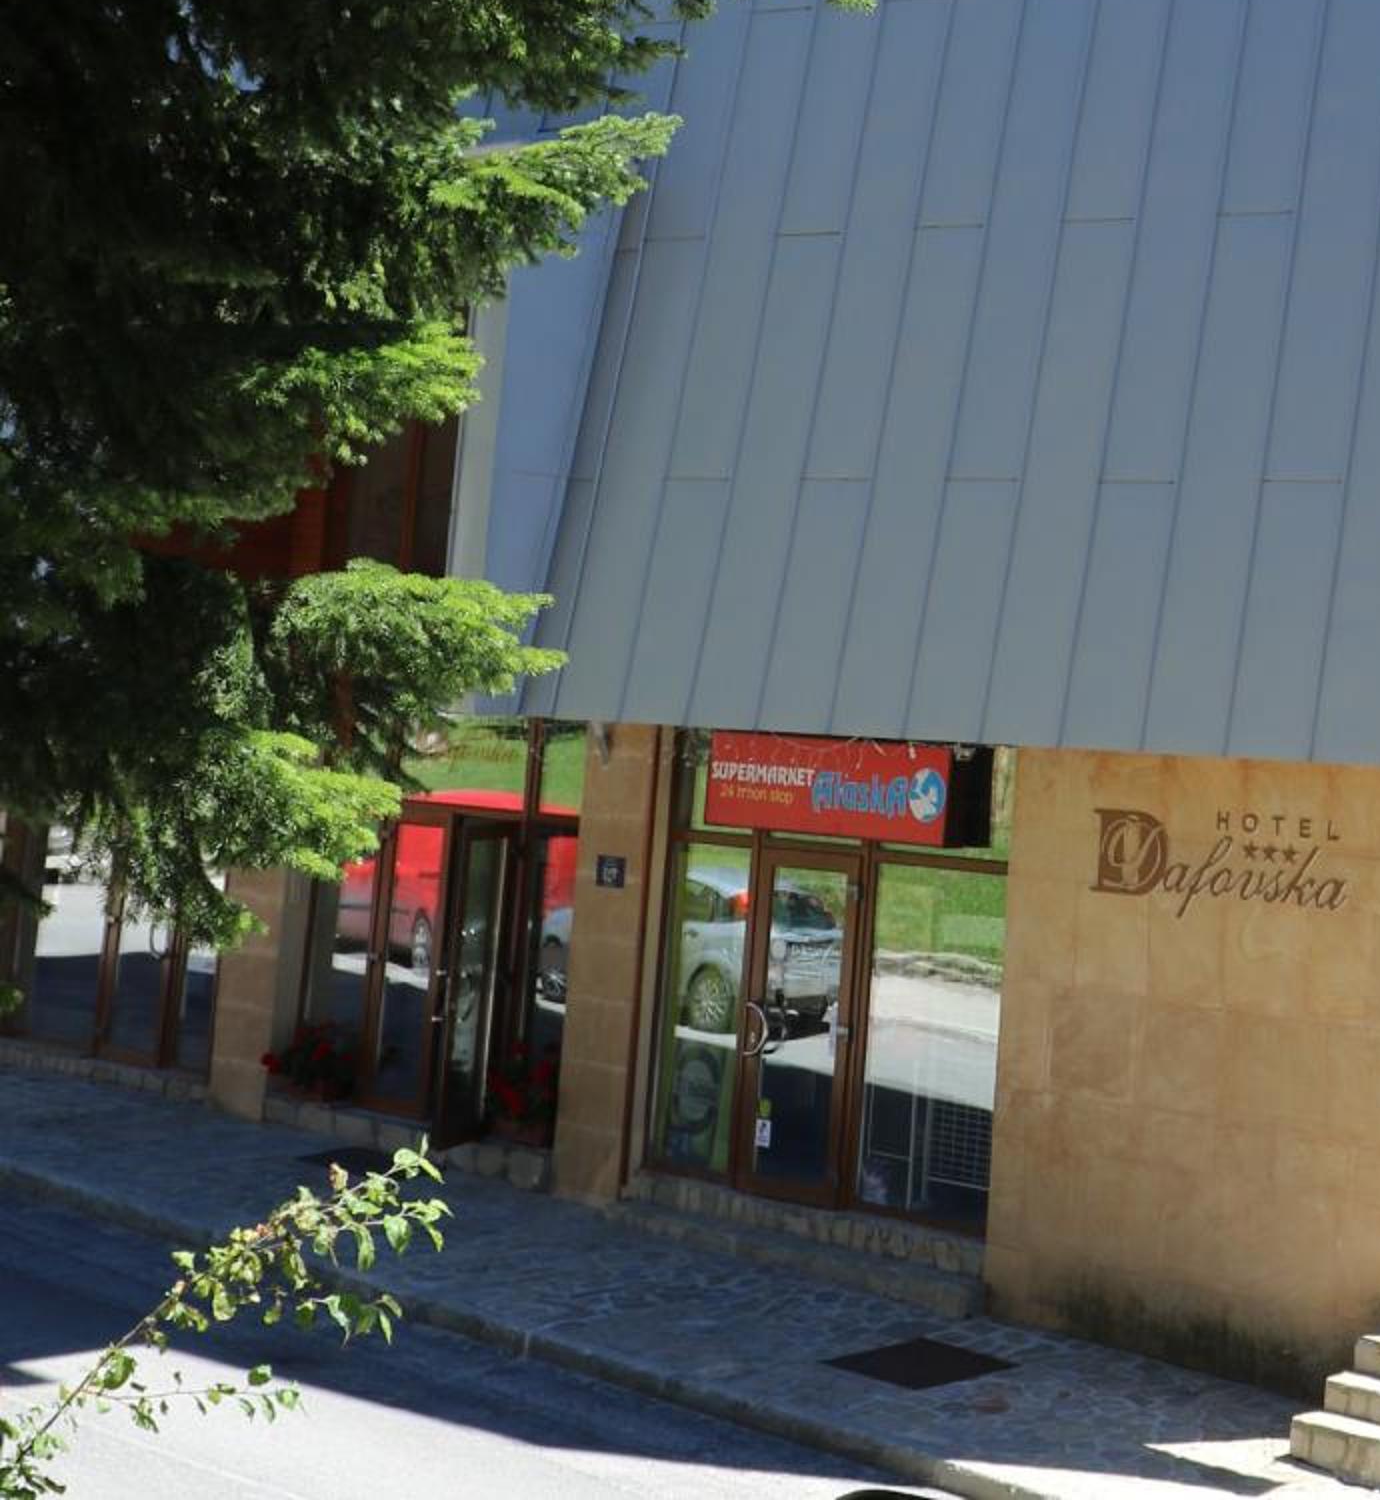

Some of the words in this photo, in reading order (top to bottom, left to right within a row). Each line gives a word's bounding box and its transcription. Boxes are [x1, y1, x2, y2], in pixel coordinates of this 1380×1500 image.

[711, 760, 816, 788] SUPERMARKET
[1215, 810, 1341, 841] HOTEL
[1089, 807, 1347, 919] Dafovska
